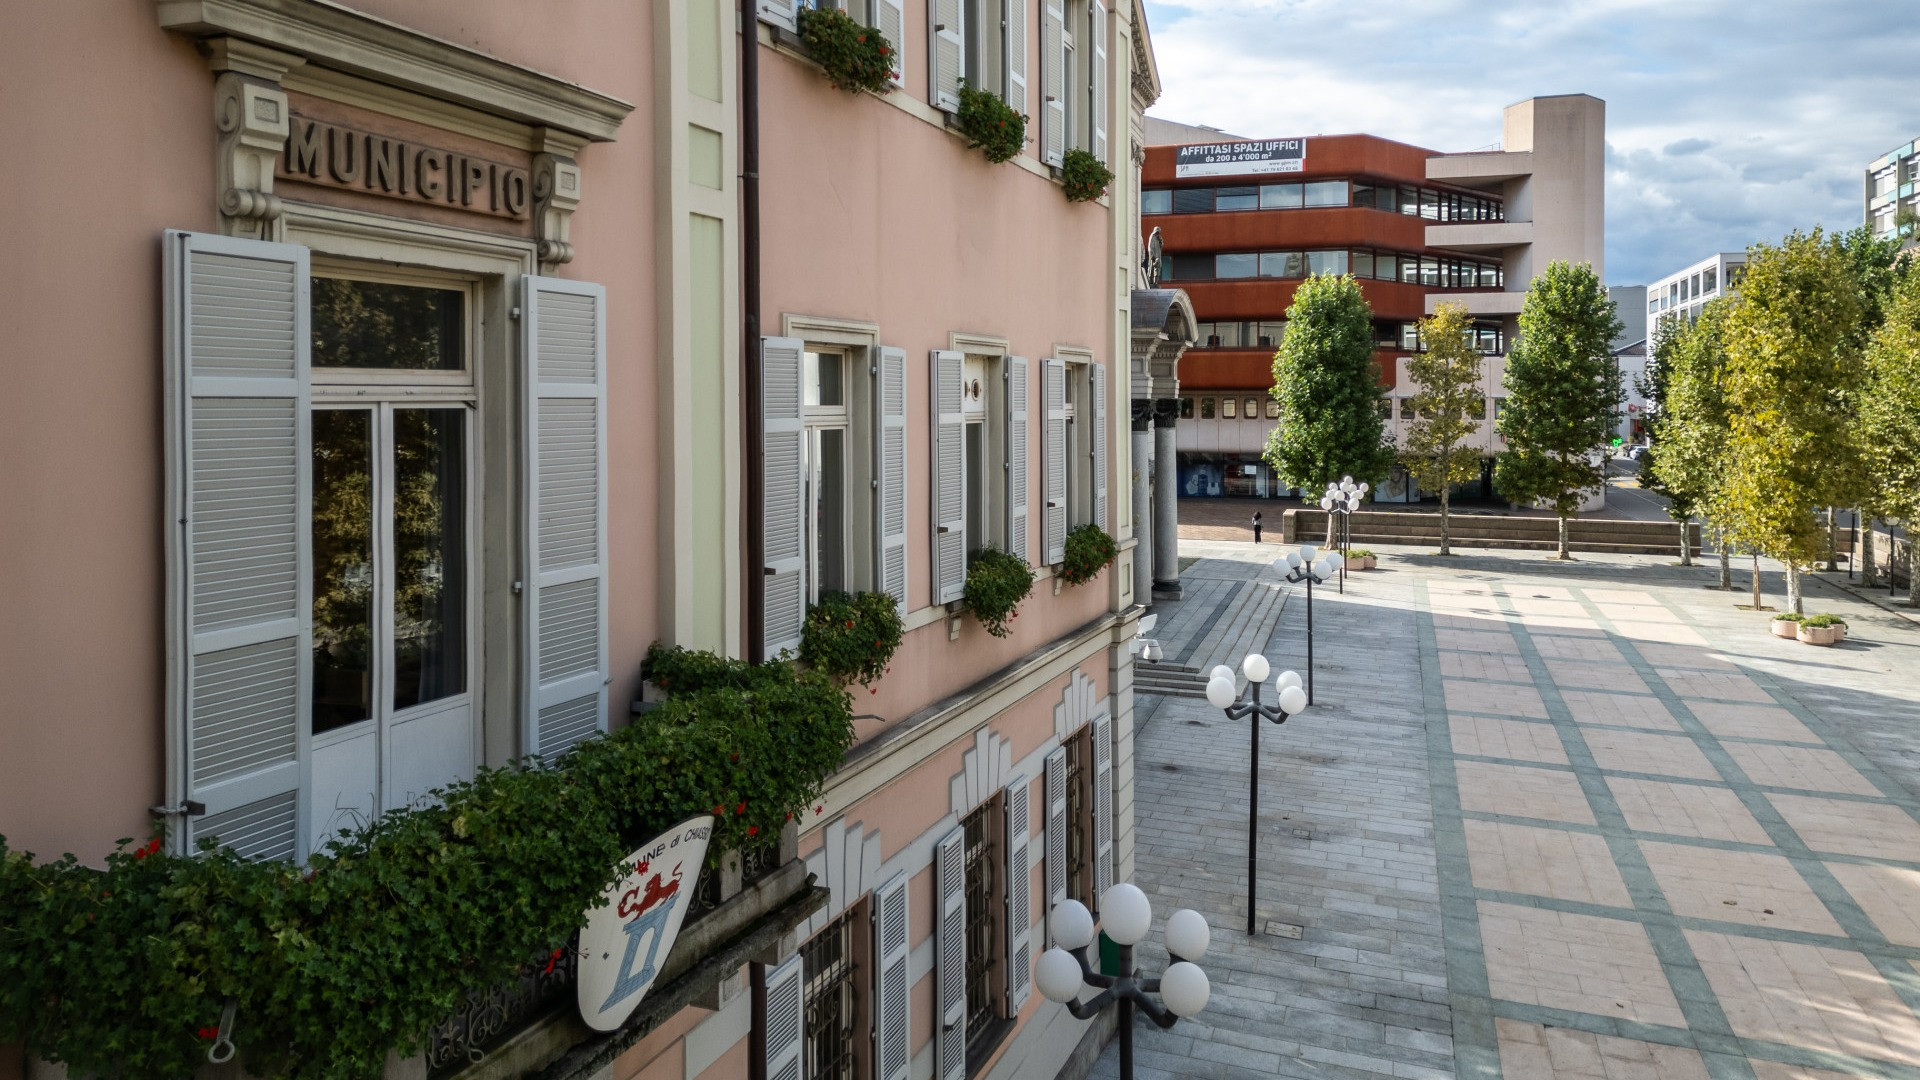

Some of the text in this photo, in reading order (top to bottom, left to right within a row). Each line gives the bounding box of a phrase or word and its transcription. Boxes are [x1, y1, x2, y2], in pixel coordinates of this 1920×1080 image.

[1181, 140, 1299, 156] AFFITTASI SPAZI UFFICI
[284, 117, 529, 216] MUNICIPIO
[671, 834, 681, 848] di
